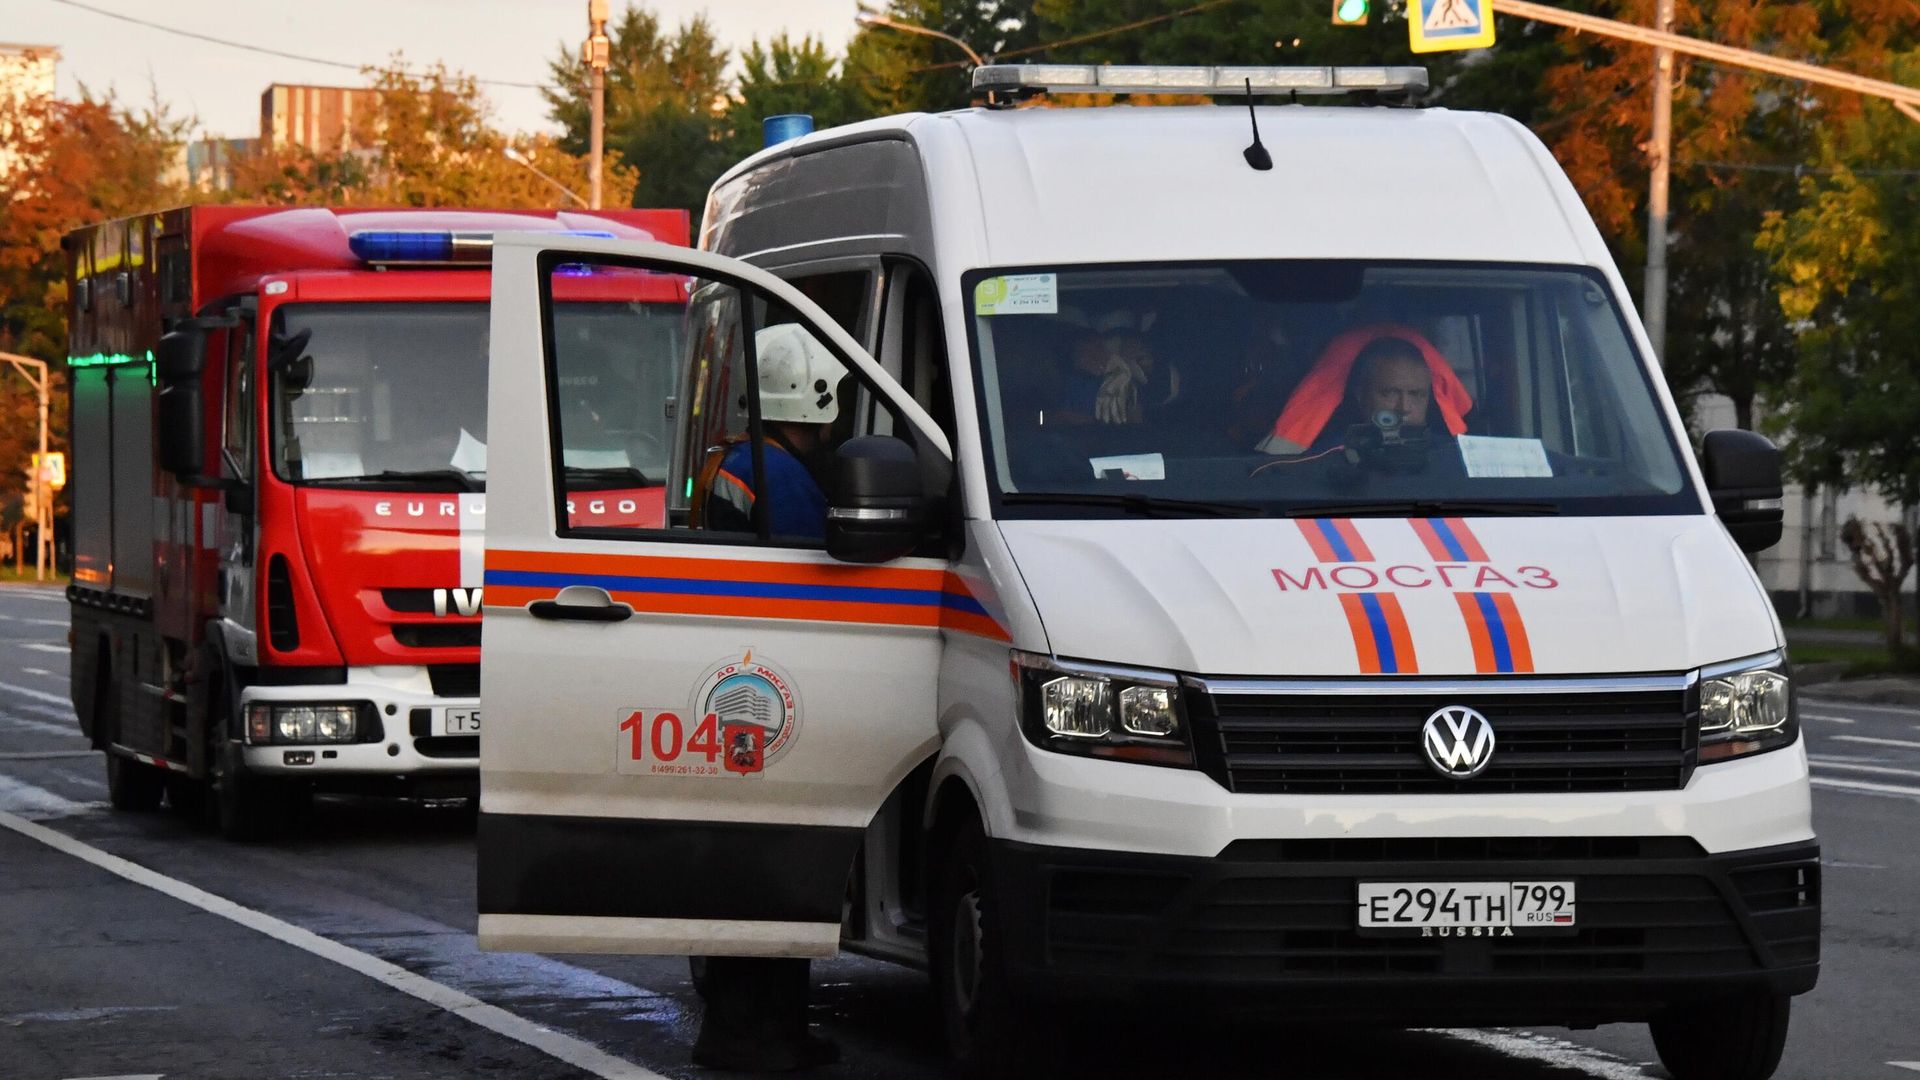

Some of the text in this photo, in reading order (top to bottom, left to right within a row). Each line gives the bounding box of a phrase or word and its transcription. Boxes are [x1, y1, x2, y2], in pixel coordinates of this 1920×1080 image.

[1271, 564, 1559, 592] МОСГАЗ
[619, 711, 722, 763] 104
[1513, 885, 1566, 911] 799
[1527, 912, 1553, 922] RUS
[1421, 926, 1514, 937] RUSSIA
